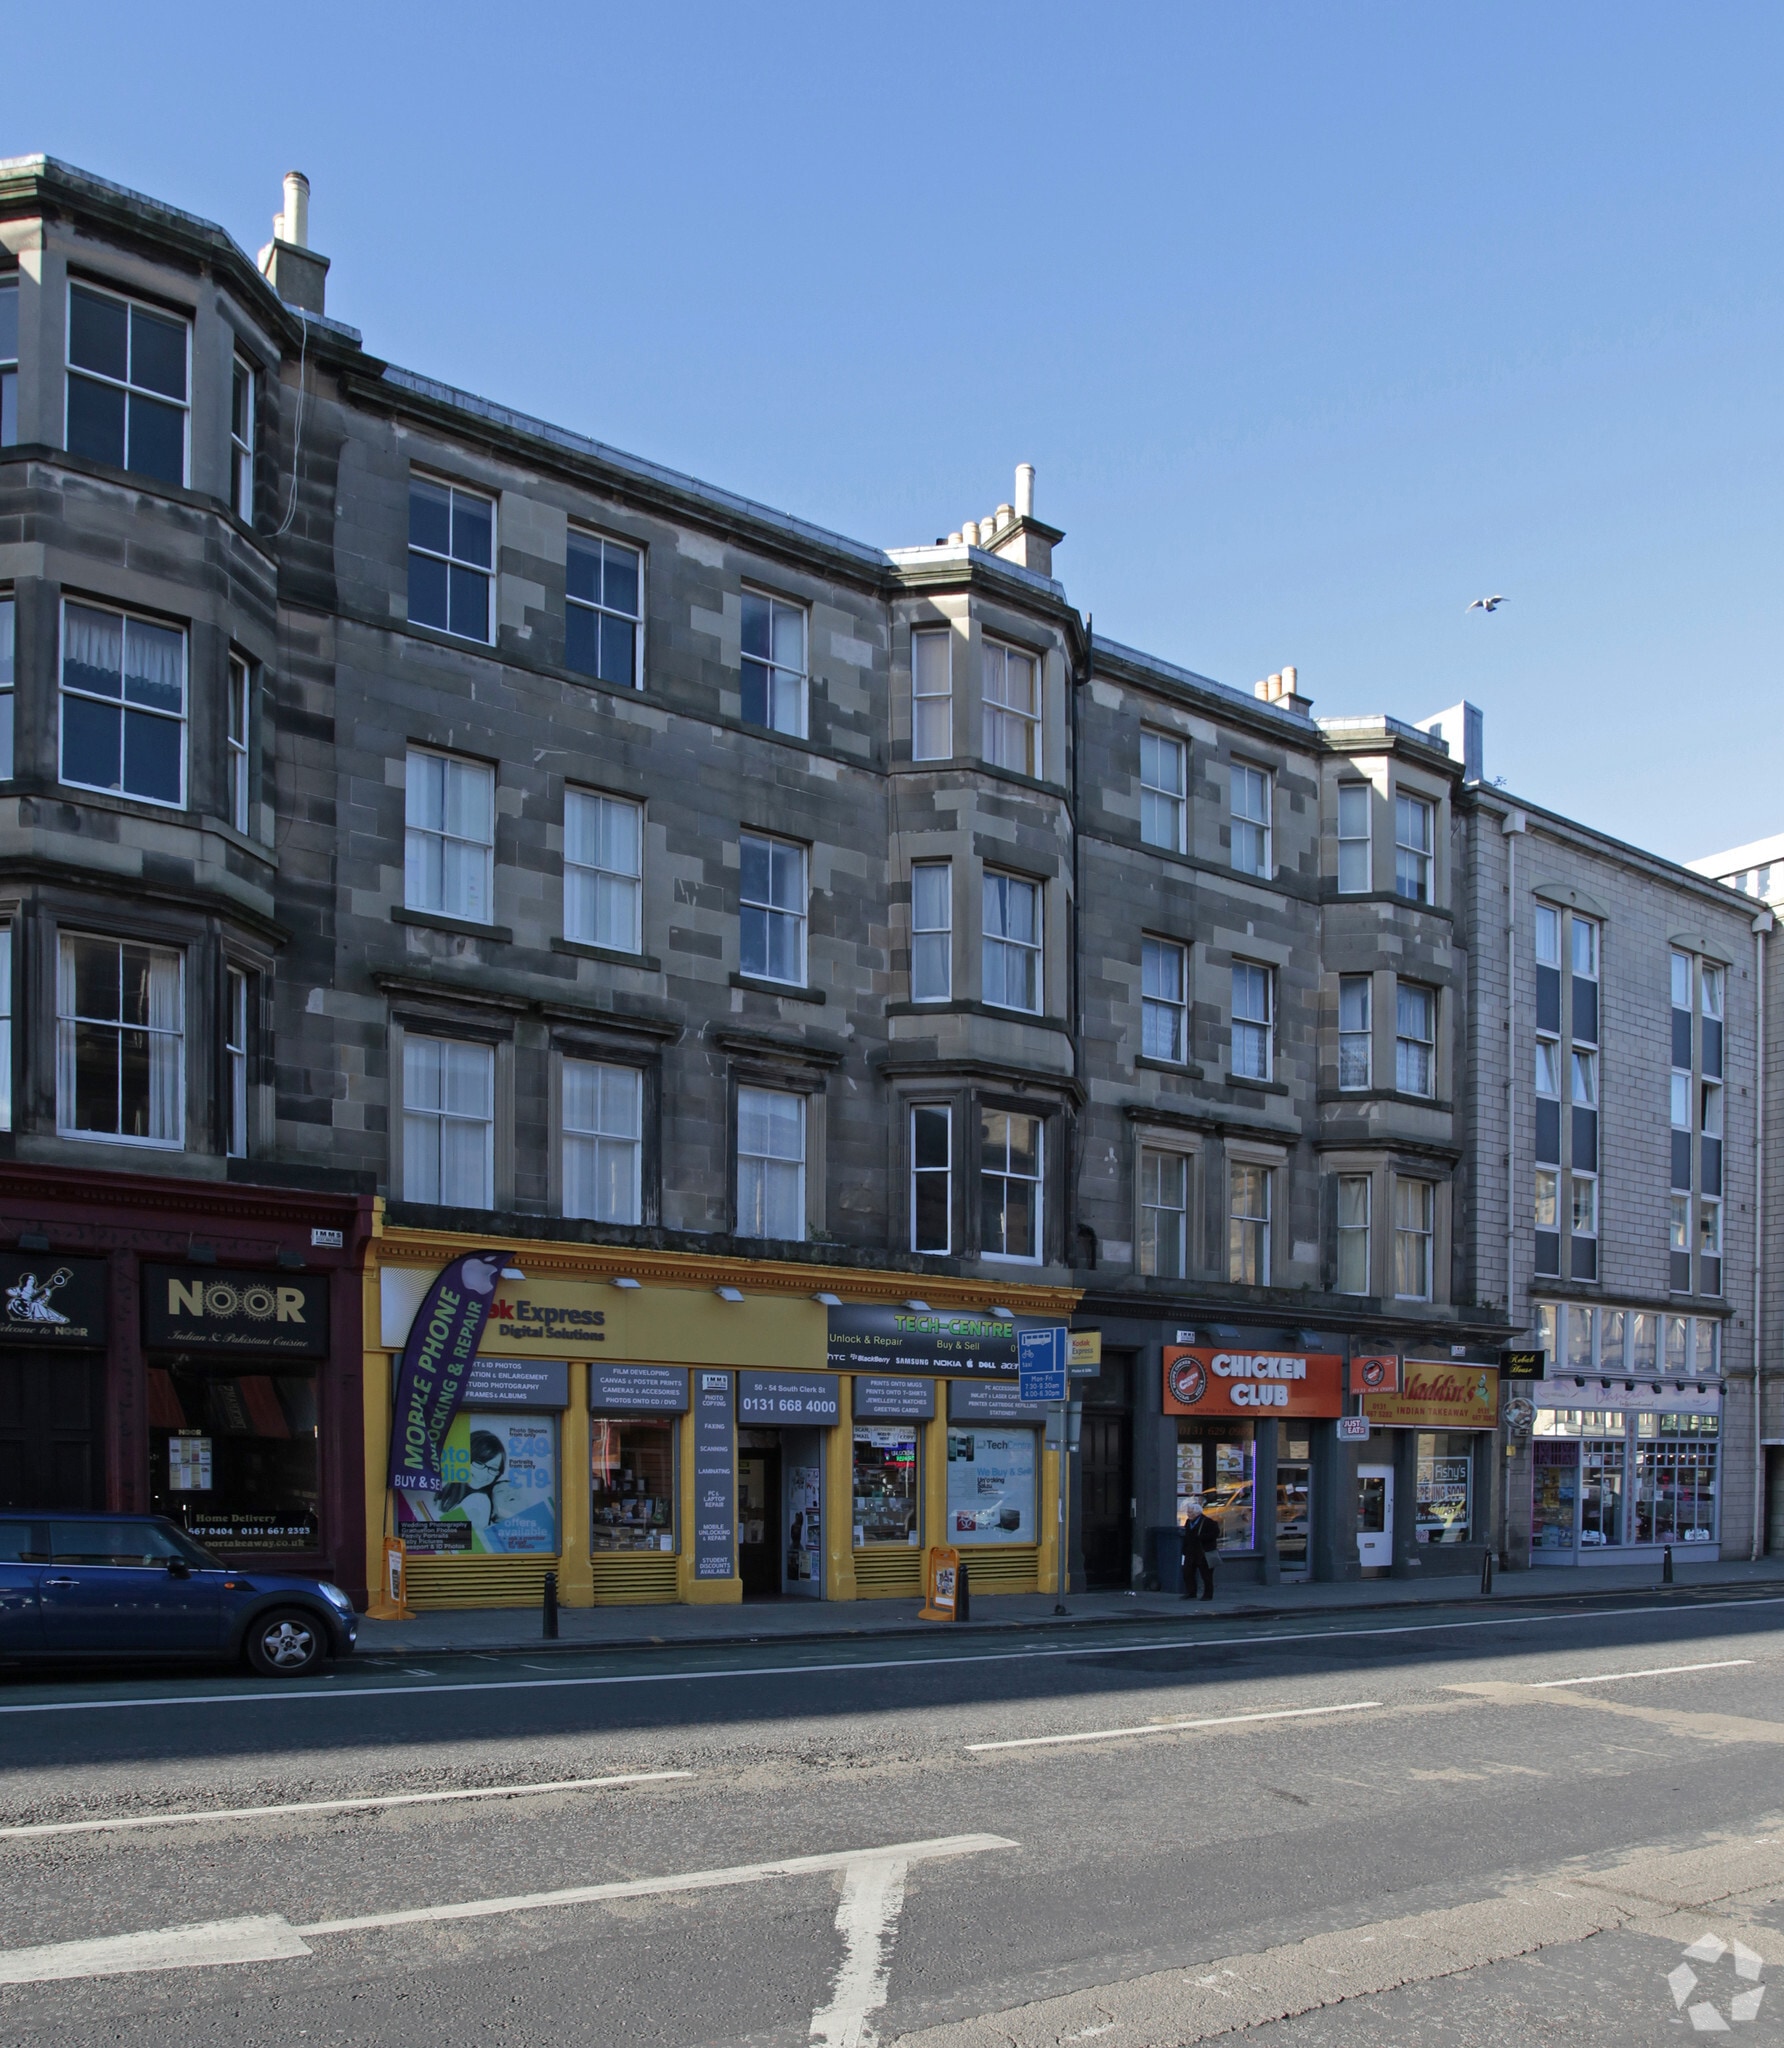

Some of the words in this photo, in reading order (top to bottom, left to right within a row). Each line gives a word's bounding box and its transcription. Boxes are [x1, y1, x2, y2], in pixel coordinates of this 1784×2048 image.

[315, 1230, 341, 1238] IMMS
[168, 1279, 306, 1324] NOOR
[517, 1300, 605, 1327] Express
[40, 1326, 51, 1335] to
[55, 1326, 88, 1337] NOOR
[418, 1286, 461, 1374] PHONE
[453, 1301, 483, 1359] REPAIR
[500, 1324, 543, 1339] Digital
[546, 1327, 605, 1341] Solutions
[894, 1315, 1013, 1338] TECH-CENTRE
[168, 1330, 206, 1342] Indian
[209, 1332, 222, 1343] &
[222, 1332, 272, 1346] Pakistani
[273, 1335, 309, 1348] Cuisine
[829, 1333, 861, 1344] Unlock
[864, 1336, 870, 1344] &
[873, 1336, 903, 1346] Repair
[936, 1340, 952, 1350] Buy
[956, 1342, 962, 1350] &
[964, 1341, 980, 1350] Sell
[1072, 1347, 1093, 1355] Express
[857, 1354, 891, 1364] BlackBerry
[896, 1357, 929, 1366] SAMSUNG
[933, 1359, 962, 1368] NOKIA
[979, 1361, 996, 1369] DELL
[1211, 1354, 1307, 1379] CHICKEN
[447, 1363, 464, 1376] &
[1031, 1374, 1053, 1382] Mon-Fri
[490, 1382, 539, 1390] PHOTOGRAPHY
[1230, 1383, 1289, 1406] CLUB
[743, 1398, 774, 1410] 0131
[779, 1399, 802, 1411] 668
[805, 1400, 836, 1413] 4000
[1396, 1406, 1425, 1415] INDIAN
[1427, 1407, 1469, 1417] TAKEAWAY
[509, 1437, 550, 1457] £49
[977, 1468, 990, 1476] We
[992, 1467, 1008, 1477] Buy
[1018, 1467, 1032, 1476] Sell
[1435, 1464, 1466, 1480] Fishy's
[395, 1475, 416, 1488] BUY
[419, 1476, 428, 1488] &
[509, 1469, 550, 1489] £19
[196, 1514, 229, 1522] Home
[231, 1514, 277, 1524] Delivery
[504, 1518, 537, 1527] offers
[209, 1527, 233, 1535] 0404
[241, 1527, 264, 1535] 0131
[267, 1527, 284, 1535] 667
[497, 1528, 548, 1537] available
[204, 1540, 304, 1549] oortakeaway.co.uk
